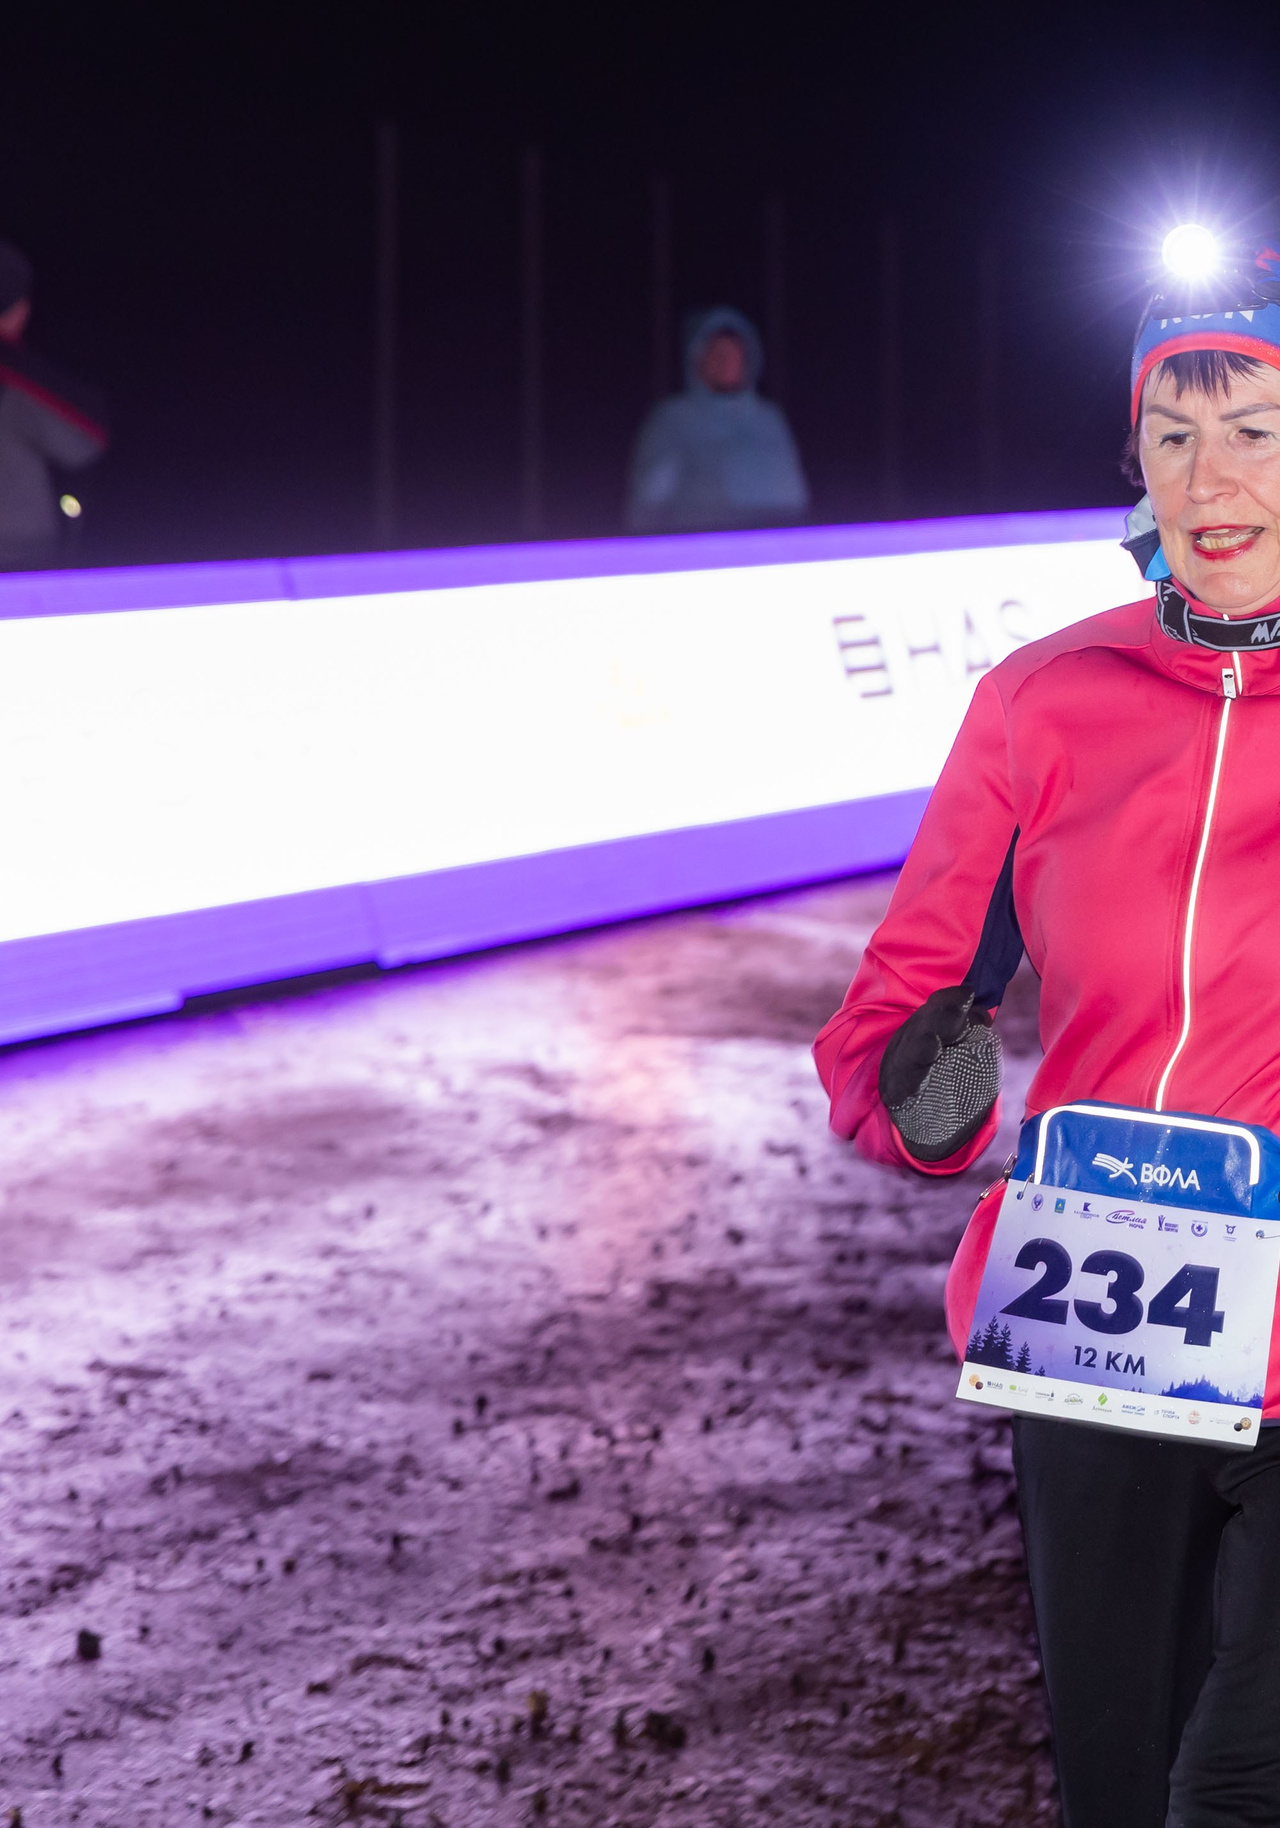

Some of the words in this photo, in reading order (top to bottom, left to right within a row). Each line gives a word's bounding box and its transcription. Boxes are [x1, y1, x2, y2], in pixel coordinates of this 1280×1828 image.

[1140, 1163, 1201, 1191] ВФЛА
[999, 1237, 1226, 1348] 234
[1073, 1345, 1096, 1368] 12
[1105, 1350, 1146, 1376] KM
